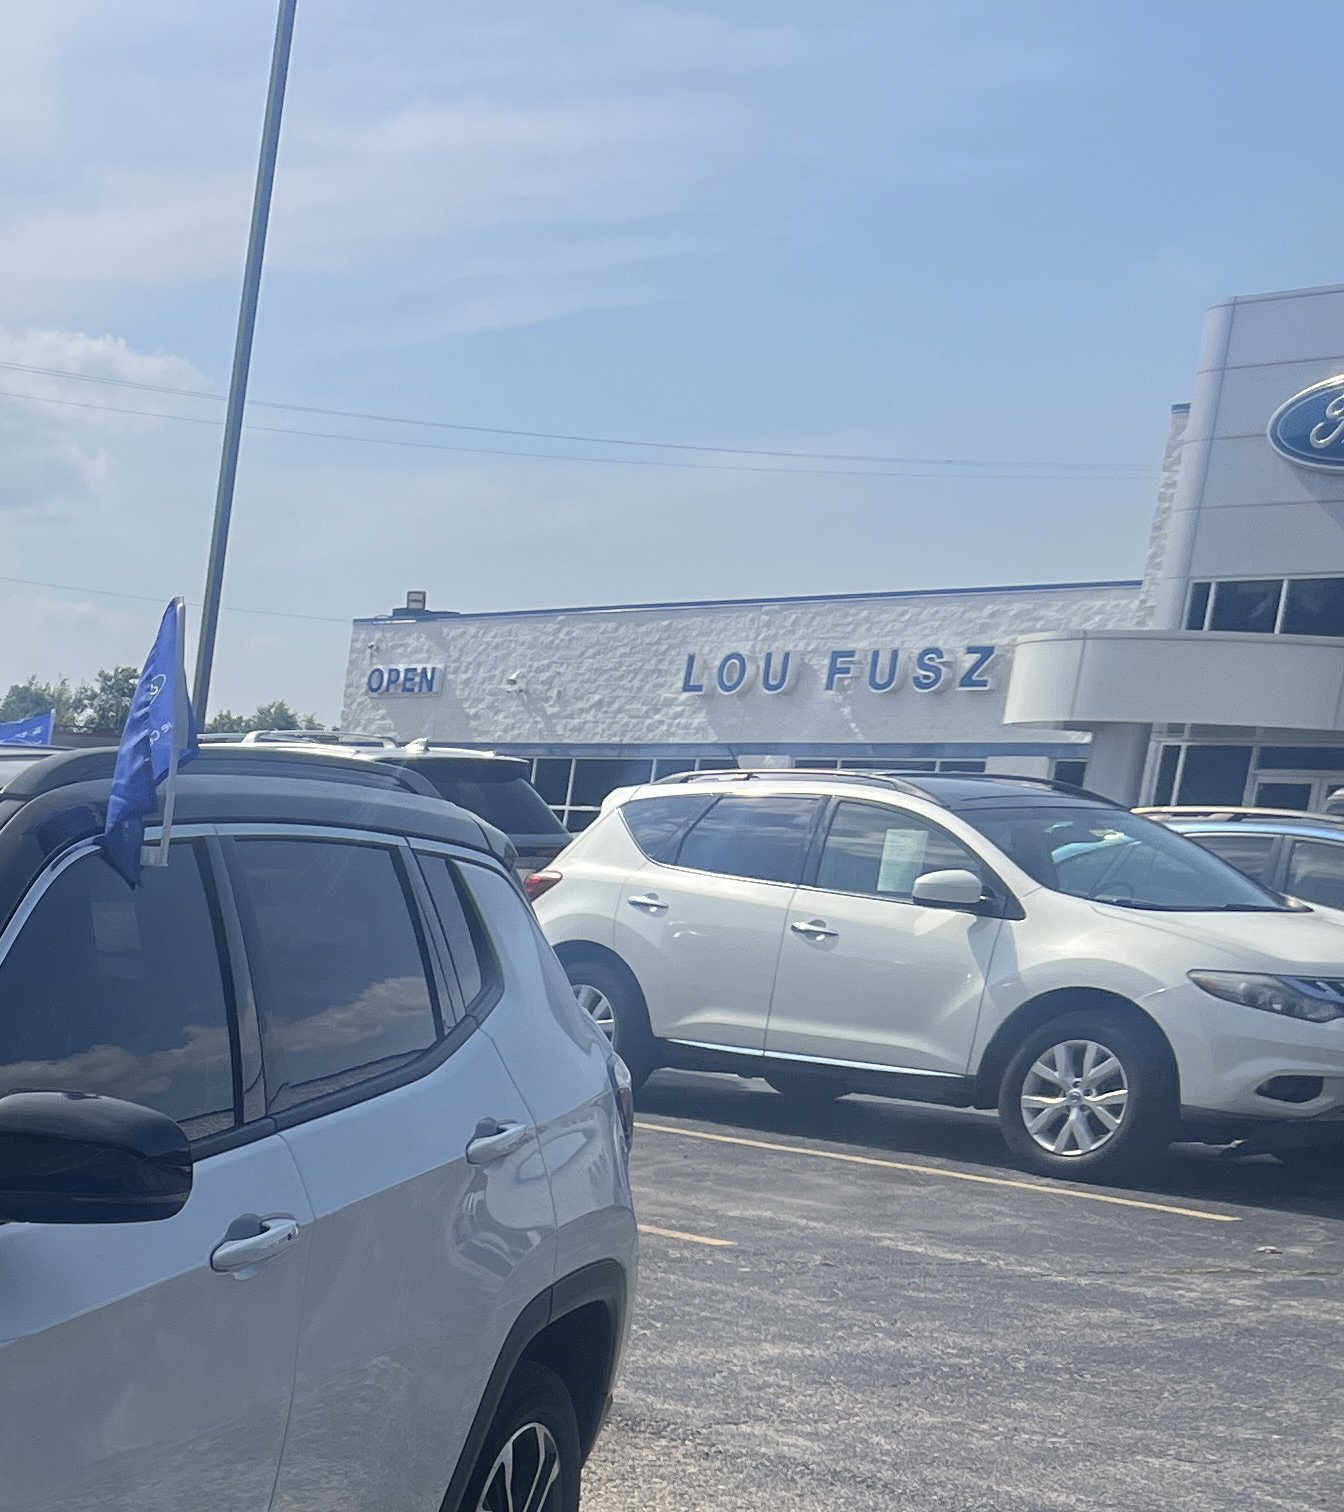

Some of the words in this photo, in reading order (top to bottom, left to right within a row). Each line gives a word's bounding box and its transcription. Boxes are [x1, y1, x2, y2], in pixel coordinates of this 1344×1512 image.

[367, 666, 437, 693] OPEN
[682, 652, 790, 693] LOU
[825, 646, 995, 692] FUSZ
